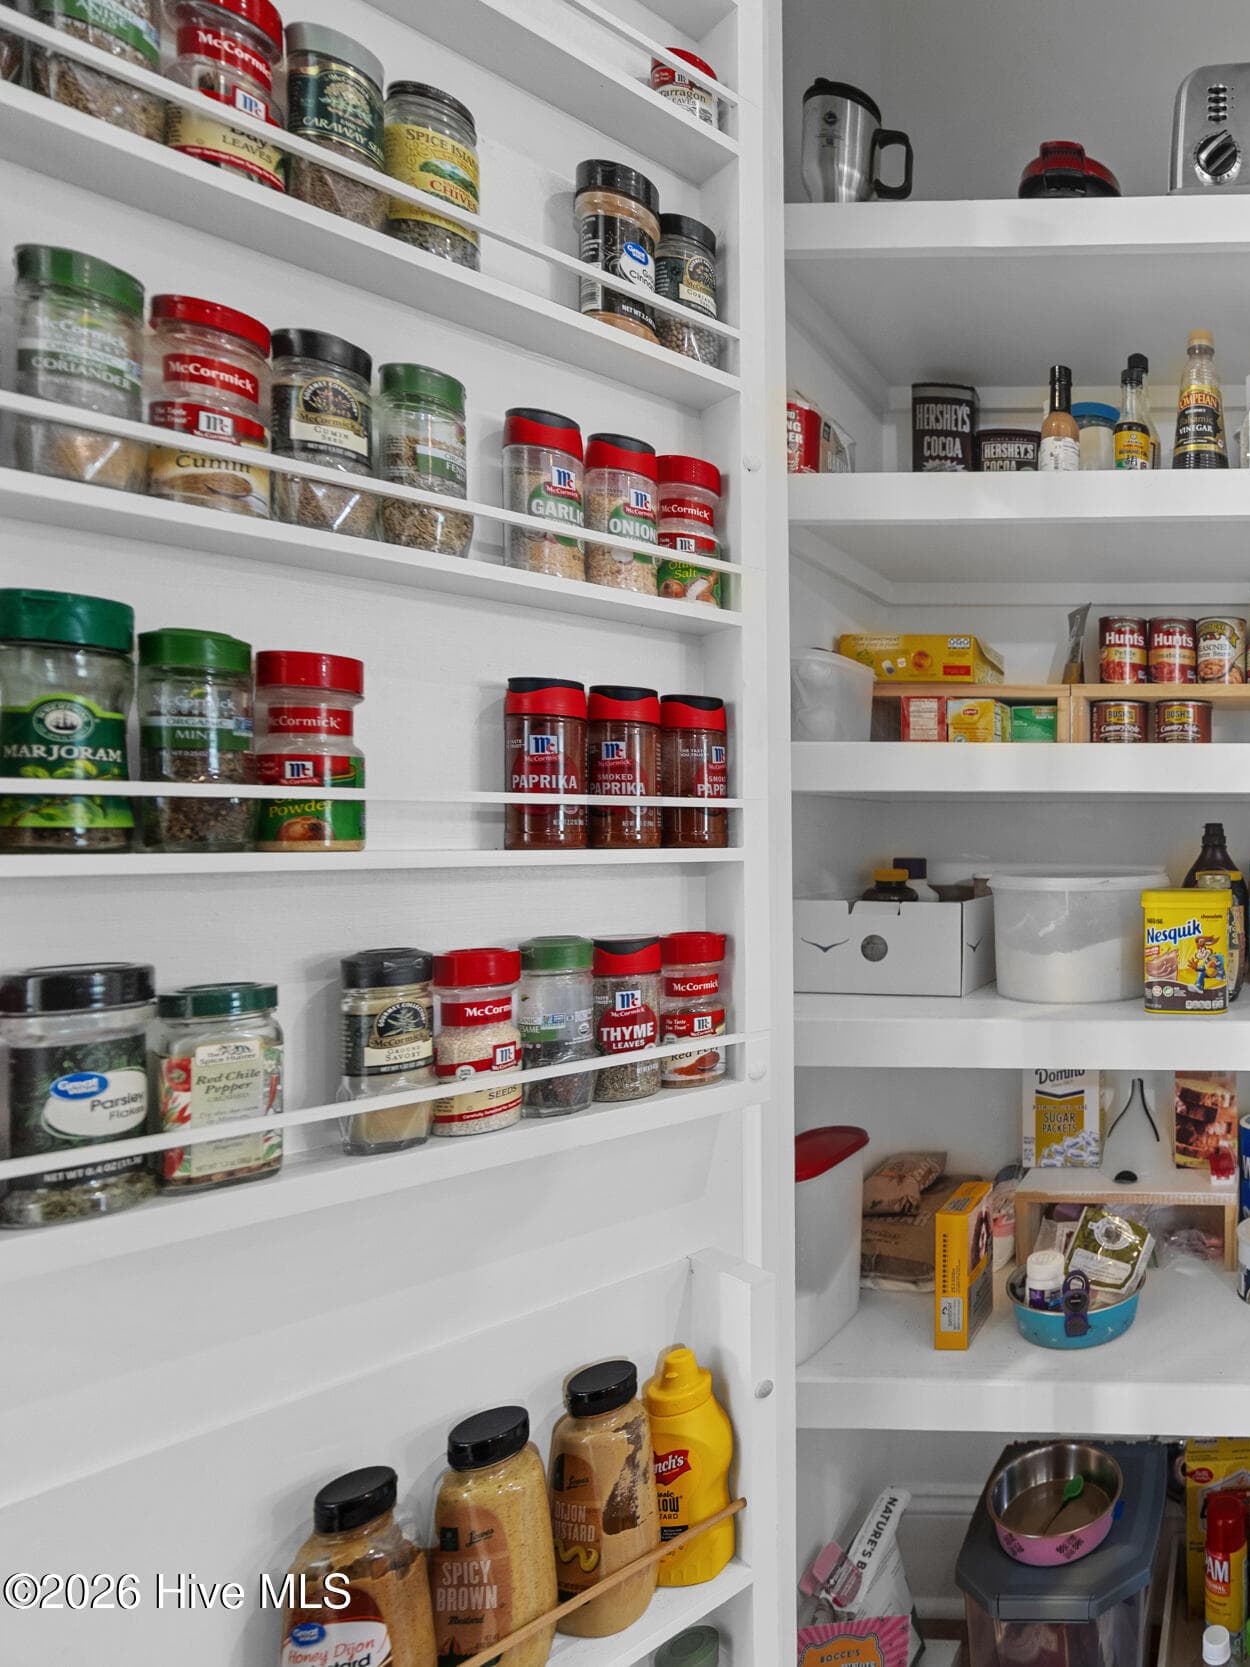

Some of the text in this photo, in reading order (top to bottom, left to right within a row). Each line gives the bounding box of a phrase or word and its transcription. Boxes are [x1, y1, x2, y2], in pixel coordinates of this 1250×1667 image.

[198, 30, 272, 81] McCormic
[302, 115, 367, 144] CARAWAY
[406, 128, 448, 150] SPICE
[222, 134, 273, 164] LEAVES
[168, 360, 255, 394] McCormick
[1179, 391, 1219, 410] OMPEIAN
[915, 402, 971, 433] HERSHEY'S
[1177, 423, 1214, 435] VINEGAR
[923, 436, 963, 458] COCOA
[984, 441, 1035, 461] HERSHEY'S
[175, 452, 251, 473] Cumin
[660, 504, 710, 521] McCormick
[674, 567, 697, 579] Salt
[2, 743, 123, 763] MARJORAM
[511, 774, 578, 790] PAPRIKA
[597, 773, 634, 781] SMOKED
[590, 781, 647, 796] PAPRIKA
[697, 783, 727, 796] PAPR
[267, 799, 333, 818] Powder
[1146, 919, 1203, 945] Nesquik
[464, 1004, 513, 1017] McCorm
[610, 1007, 646, 1018] McCormick
[600, 1021, 655, 1042] THYME
[612, 1039, 646, 1050] LEAVES
[384, 1051, 422, 1062] SAVORY
[196, 1069, 262, 1086] Red Chile
[204, 1080, 254, 1096] Pepper
[488, 1085, 518, 1101] SEEDS
[90, 1092, 144, 1113] Parsley
[109, 1105, 145, 1121] Flakes
[1043, 1112, 1076, 1123] SUGAR
[1041, 1122, 1078, 1133] PACKETS
[655, 1454, 685, 1474] nch's
[554, 1501, 587, 1523] DIJON
[862, 1496, 899, 1559] NATURE'S
[442, 1559, 492, 1586] SPICY
[435, 1584, 499, 1612] BROWN
[289, 1639, 376, 1665] Honey Dijon
[819, 1649, 861, 1664] BOCCE'S
